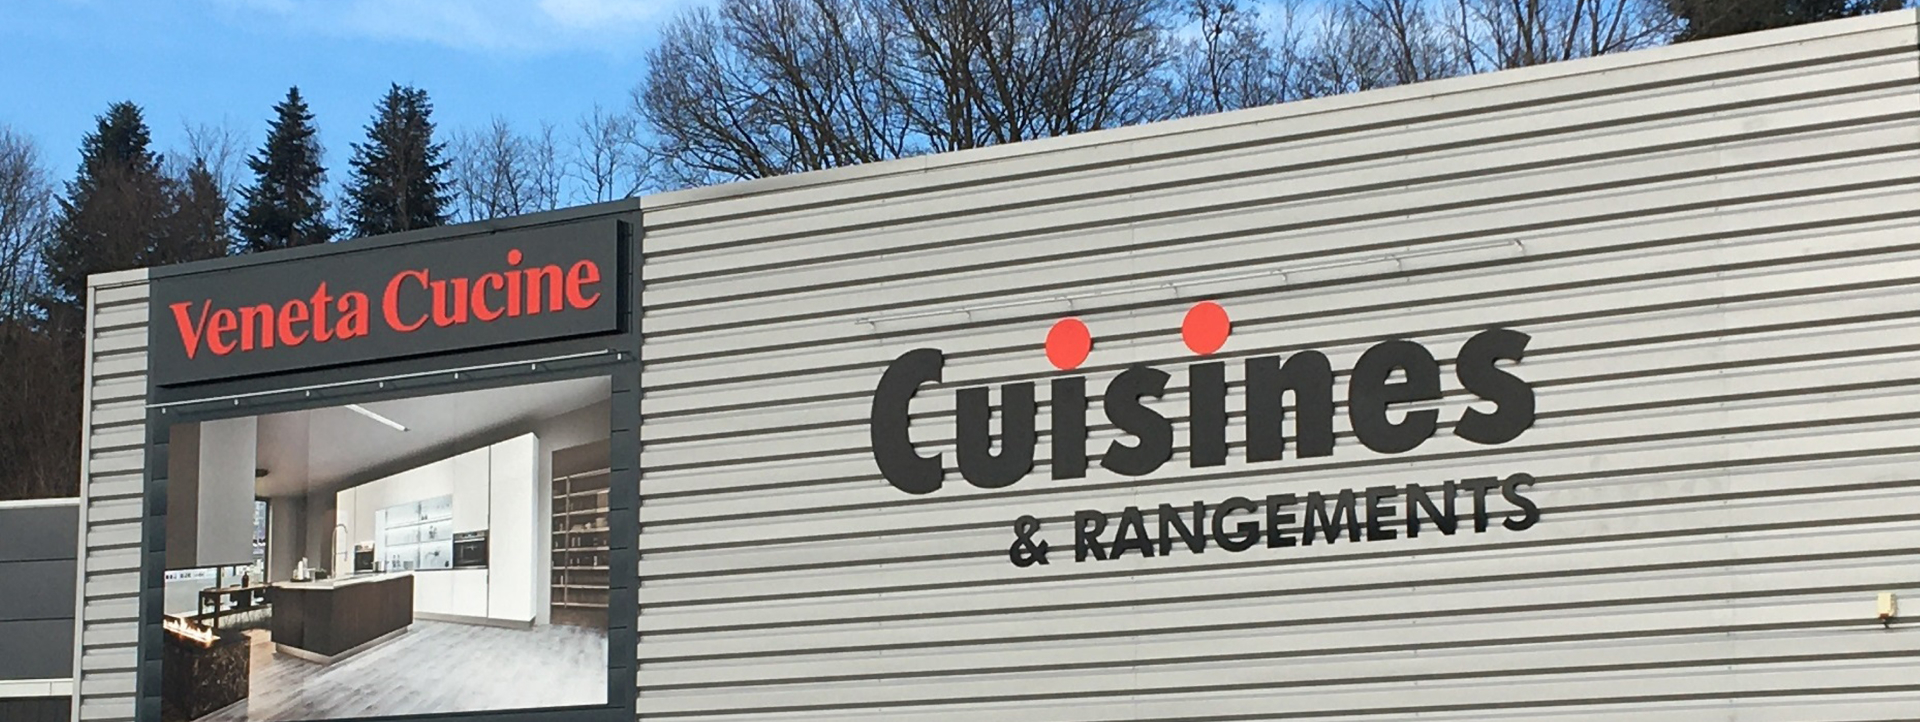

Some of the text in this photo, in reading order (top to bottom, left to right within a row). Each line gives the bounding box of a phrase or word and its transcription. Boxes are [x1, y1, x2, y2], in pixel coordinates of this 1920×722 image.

[170, 248, 601, 358] Veneta Cucine
[870, 301, 1536, 495] Cuisines
[1008, 473, 1540, 567] & RANGEMENTS
